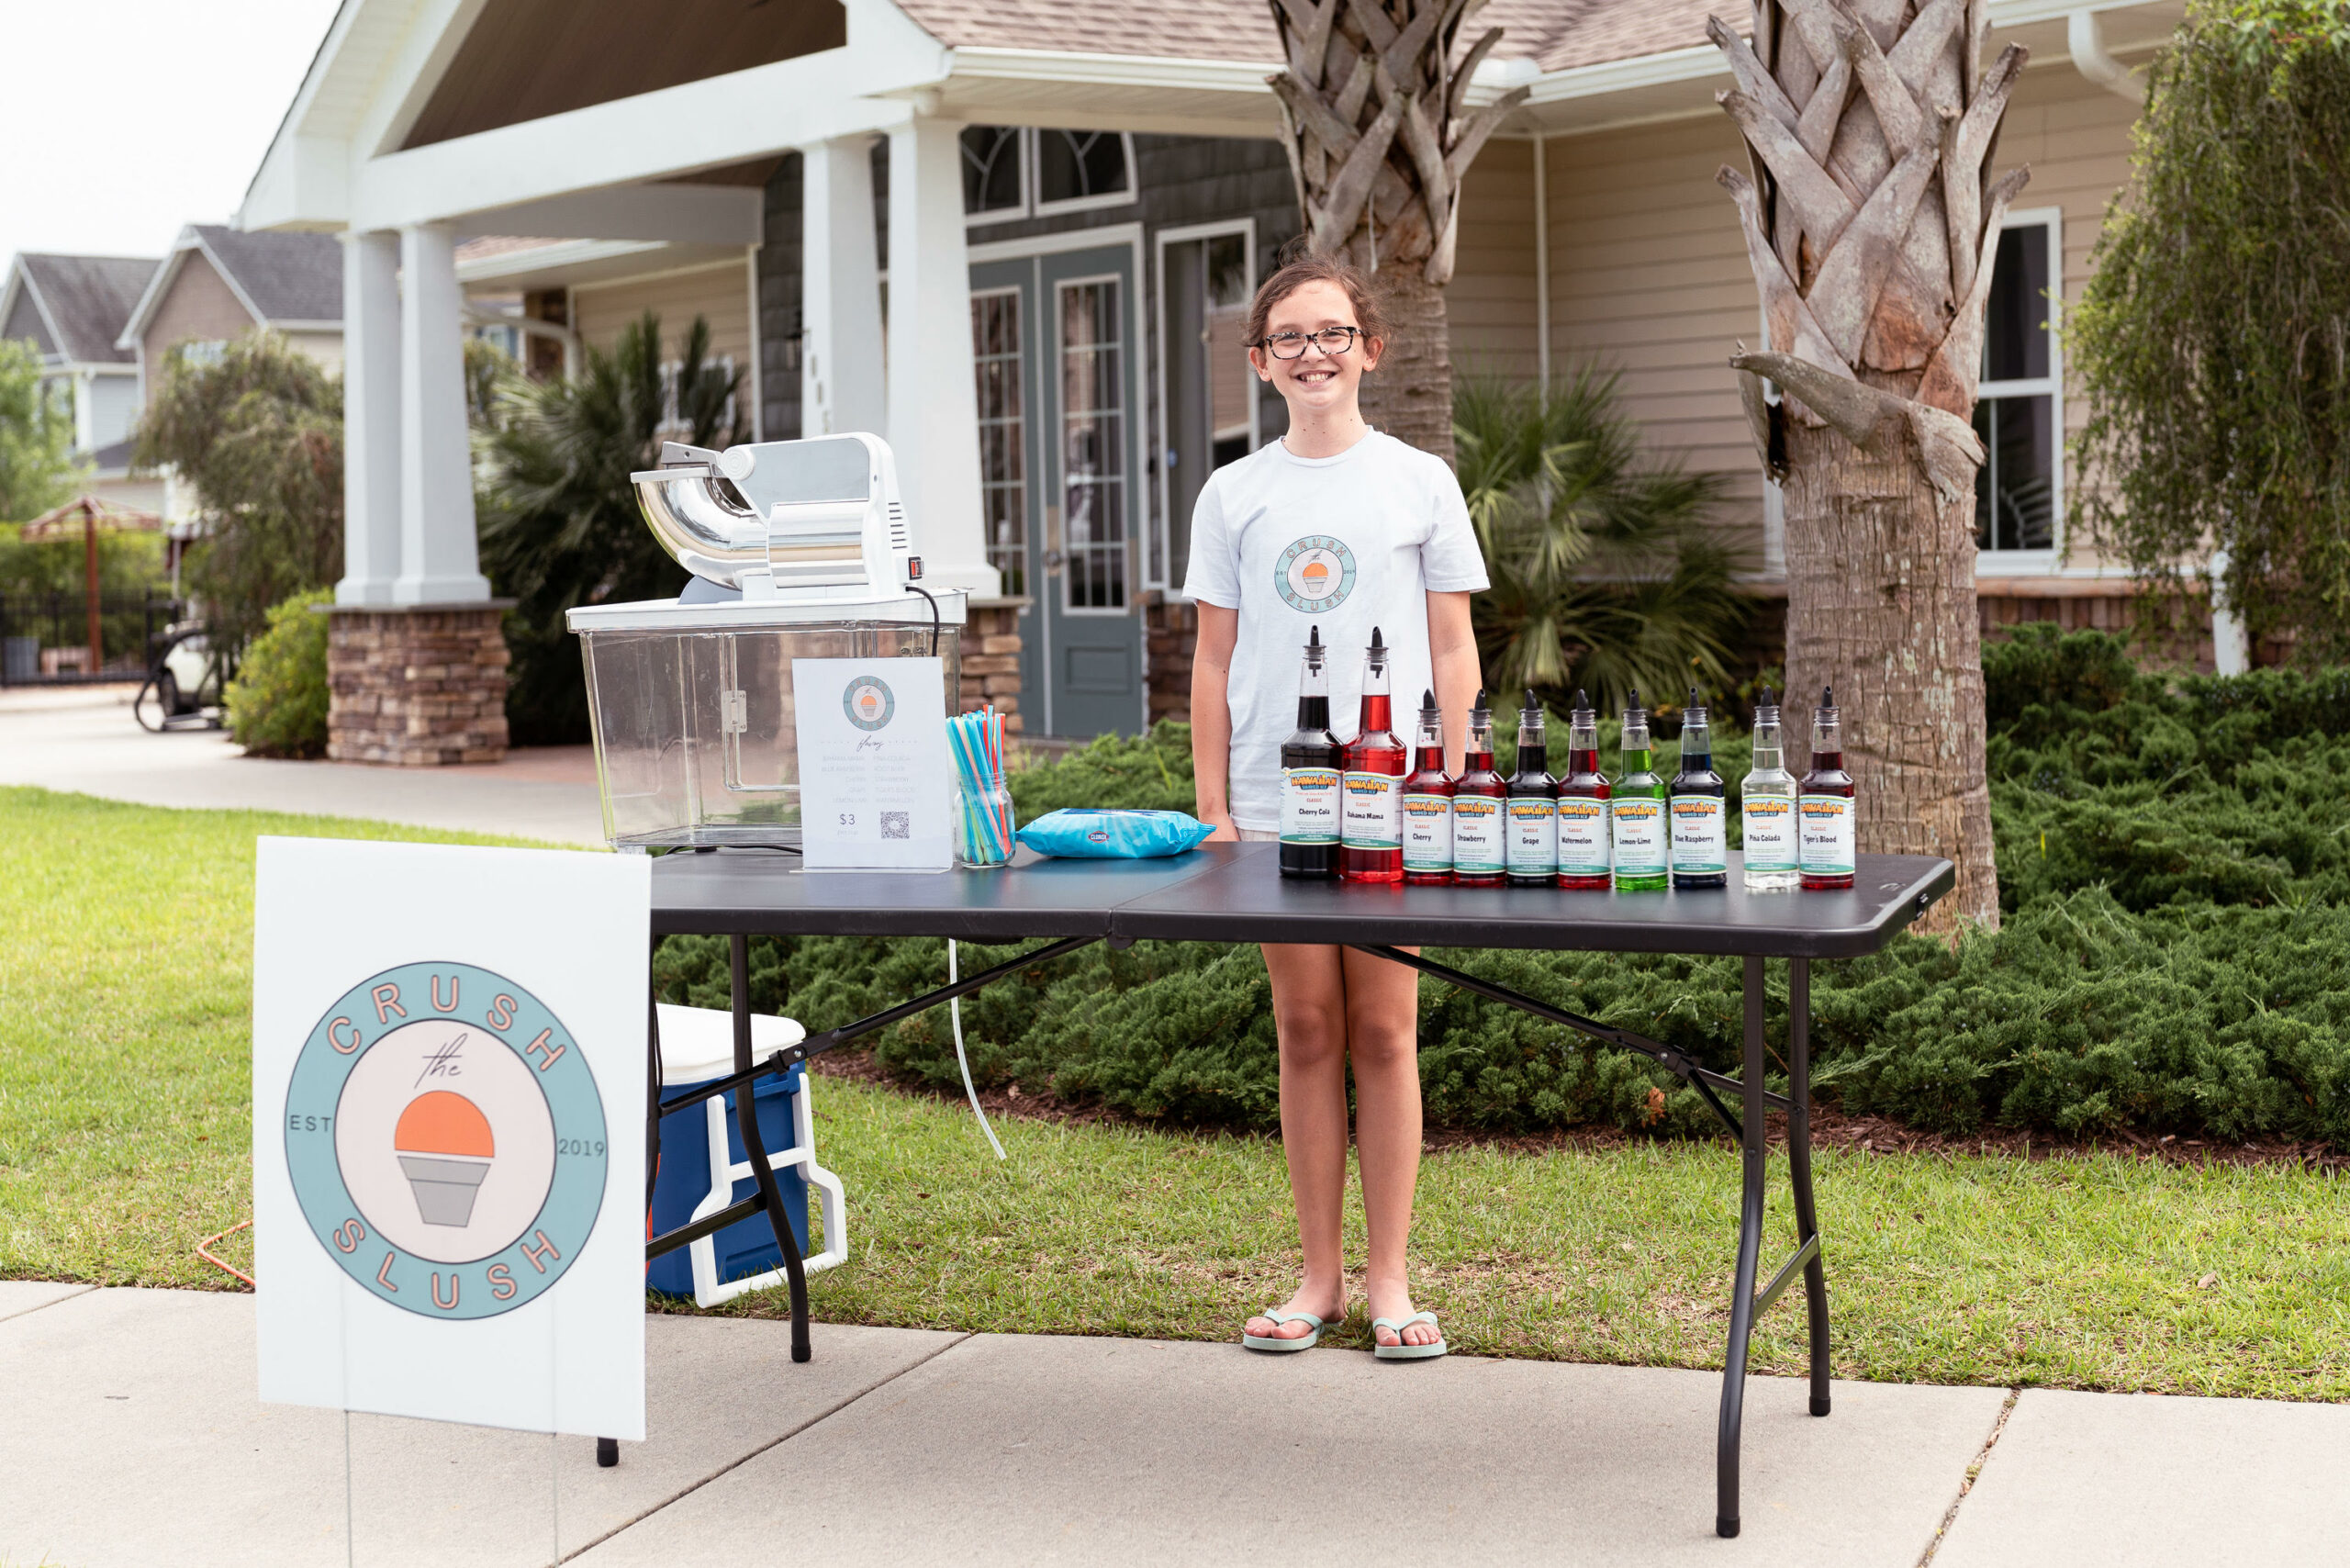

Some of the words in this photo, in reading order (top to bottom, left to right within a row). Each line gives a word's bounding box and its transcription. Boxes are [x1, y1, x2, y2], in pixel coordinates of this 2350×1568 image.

[1286, 537, 1348, 558] CRUSH
[1286, 590, 1345, 611] SLUSH
[1291, 775, 1337, 787] HAWAIIAN
[1345, 778, 1389, 792] HAWAIIAN
[1299, 808, 1317, 816] Cherry
[1404, 801, 1447, 813] HAWAIIAN
[1454, 801, 1495, 814] HAWAIIAN
[1509, 803, 1554, 816] HAWAIIAN
[1558, 803, 1600, 816] HAWAIIAN
[1614, 803, 1658, 817] HAWAIIAN
[1673, 801, 1717, 814] HAWAIIAN
[1744, 801, 1789, 813] HAWAIIAN
[1800, 801, 1844, 815] HAWAIIAN
[839, 813, 856, 825] $3
[1347, 811, 1365, 819] Bahama
[1413, 833, 1431, 842] Cherry
[1457, 834, 1486, 844] Strawberry
[1522, 837, 1539, 846] Grape
[1561, 836, 1593, 845] Watermelon
[1684, 835, 1714, 844] Raspberry
[327, 974, 567, 1072] CRUSH
[413, 1033, 468, 1090] the
[289, 1114, 332, 1133] EST
[558, 1139, 606, 1158] 2019
[333, 1217, 562, 1310] SLUSH
